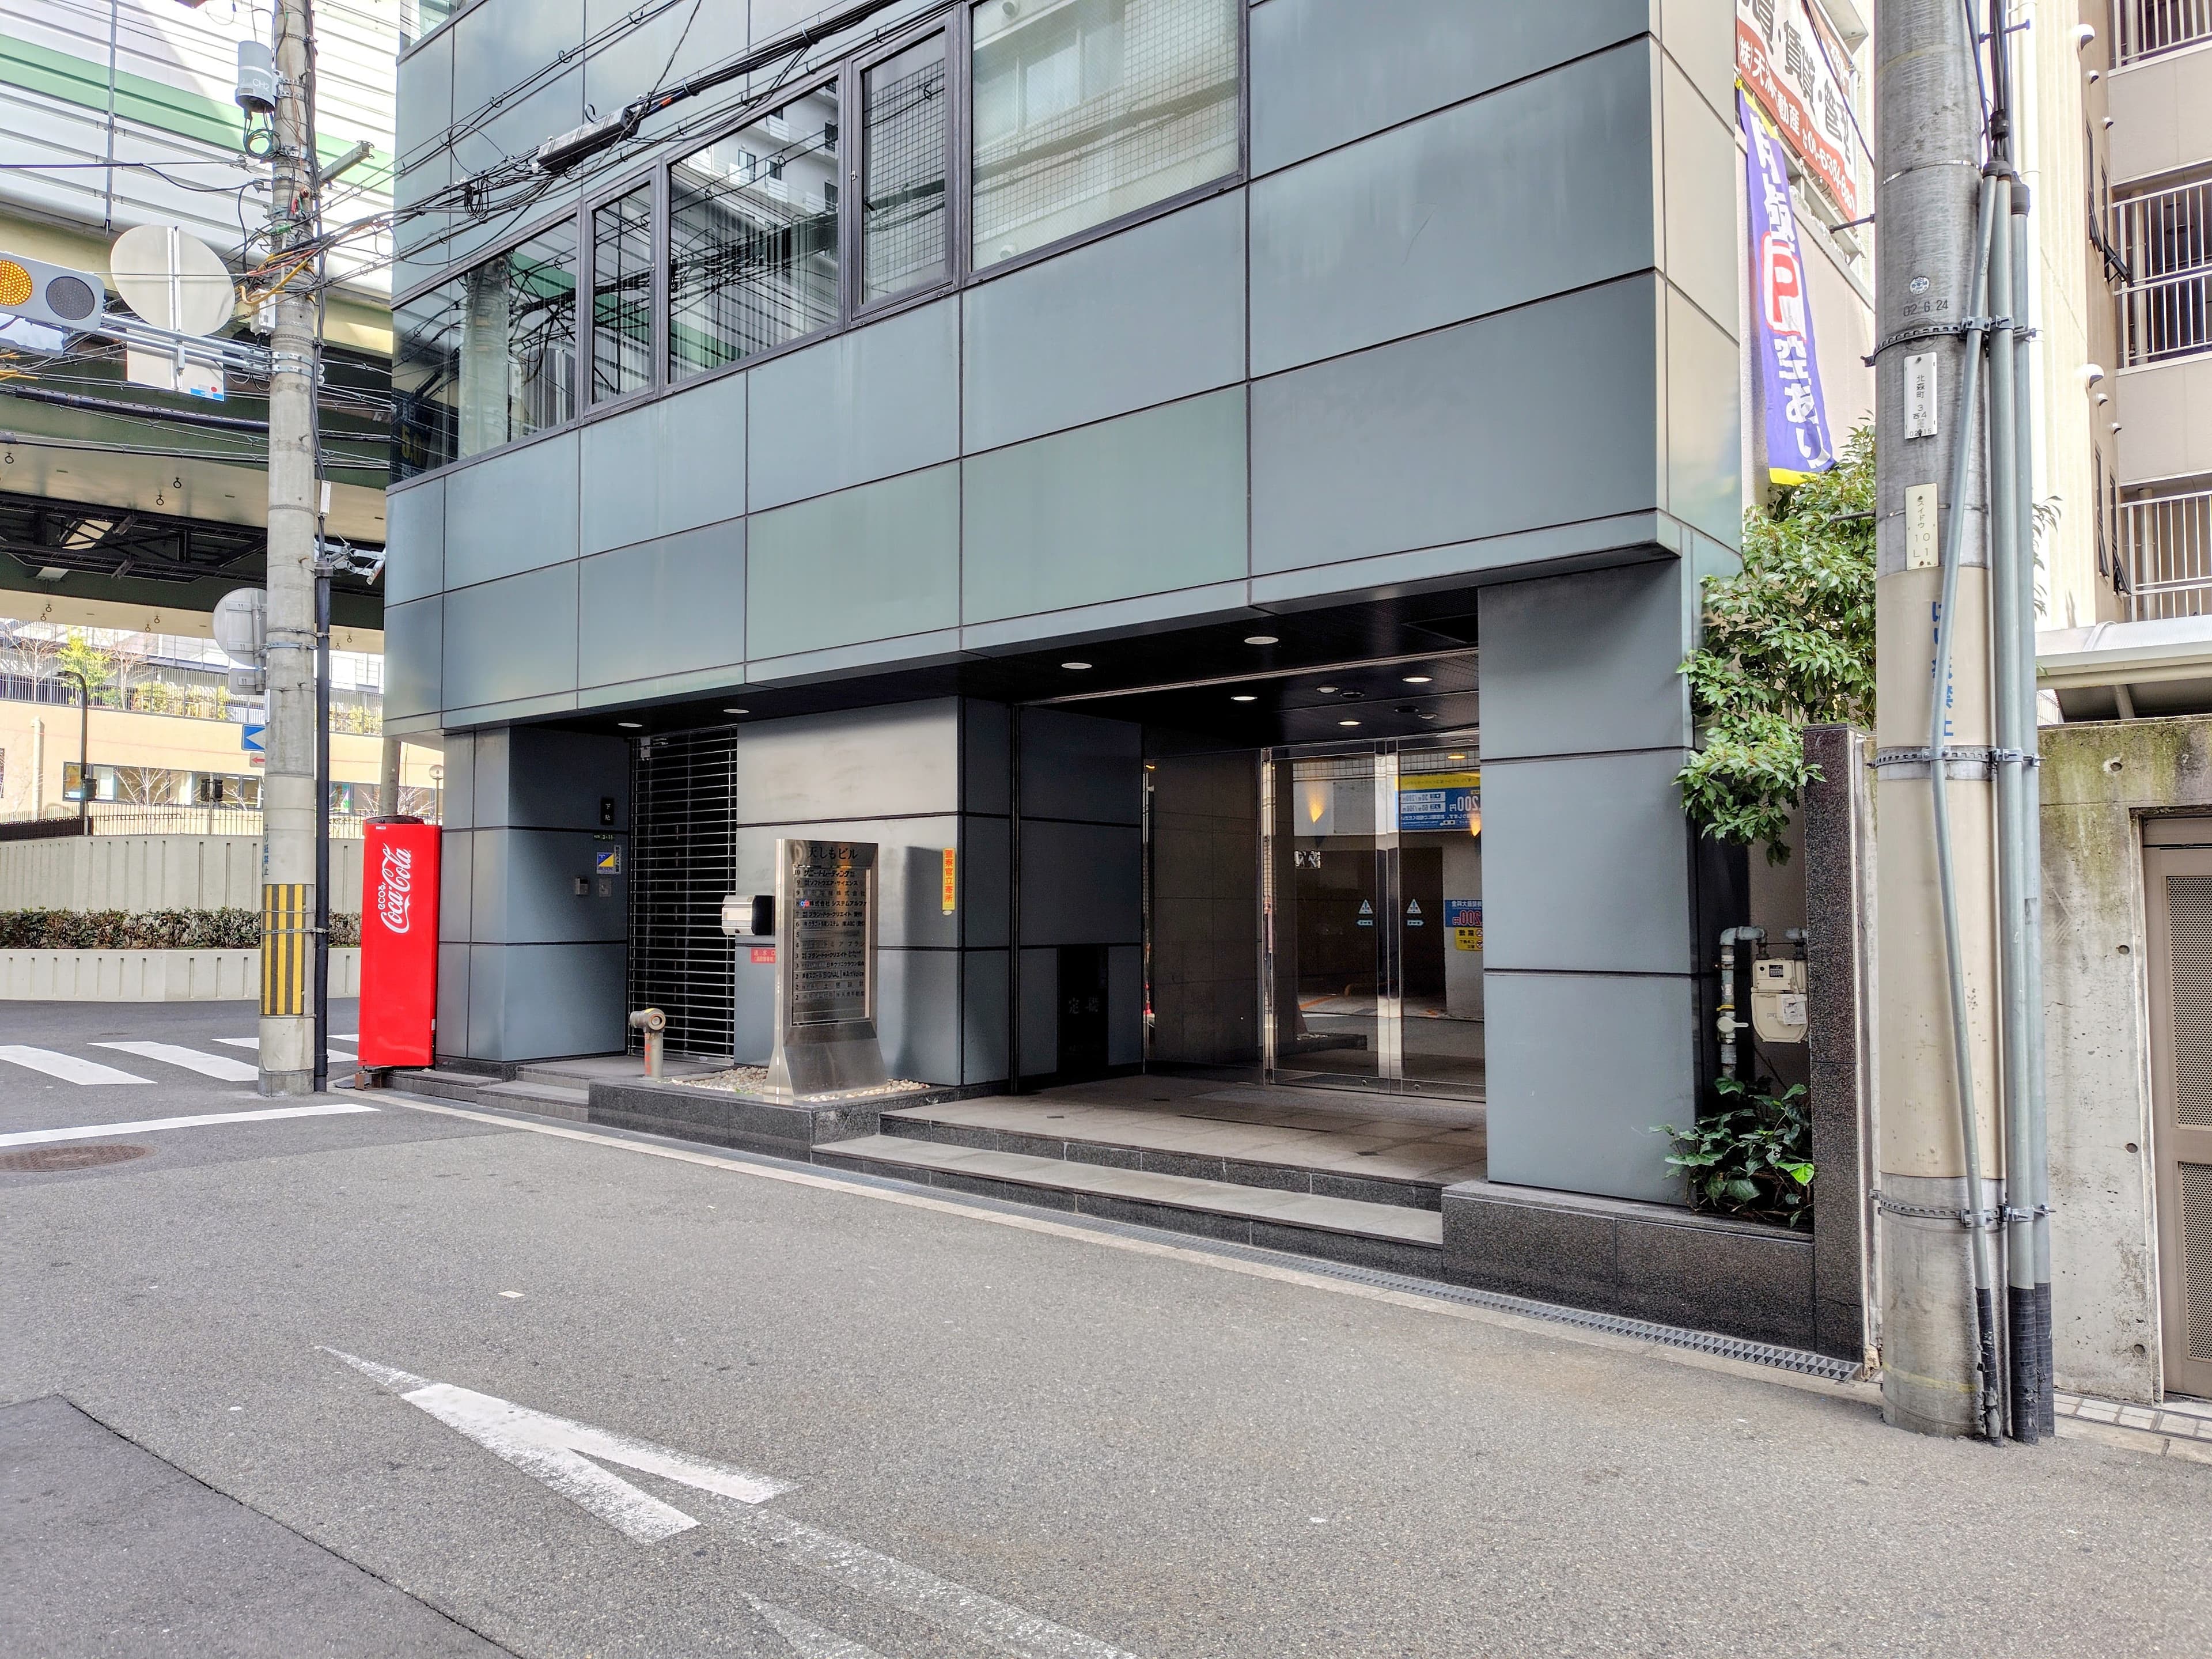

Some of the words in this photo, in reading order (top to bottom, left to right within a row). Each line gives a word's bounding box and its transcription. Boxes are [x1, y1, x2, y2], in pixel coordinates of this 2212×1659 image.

[1903, 304, 1918, 317] 02
[1924, 301, 1930, 312] 6
[1936, 299, 1948, 310] 24
[1916, 374, 1925, 399] 北森町
[1917, 501, 1925, 529] スイドウ
[380, 842, 411, 934] Coca-Cola
